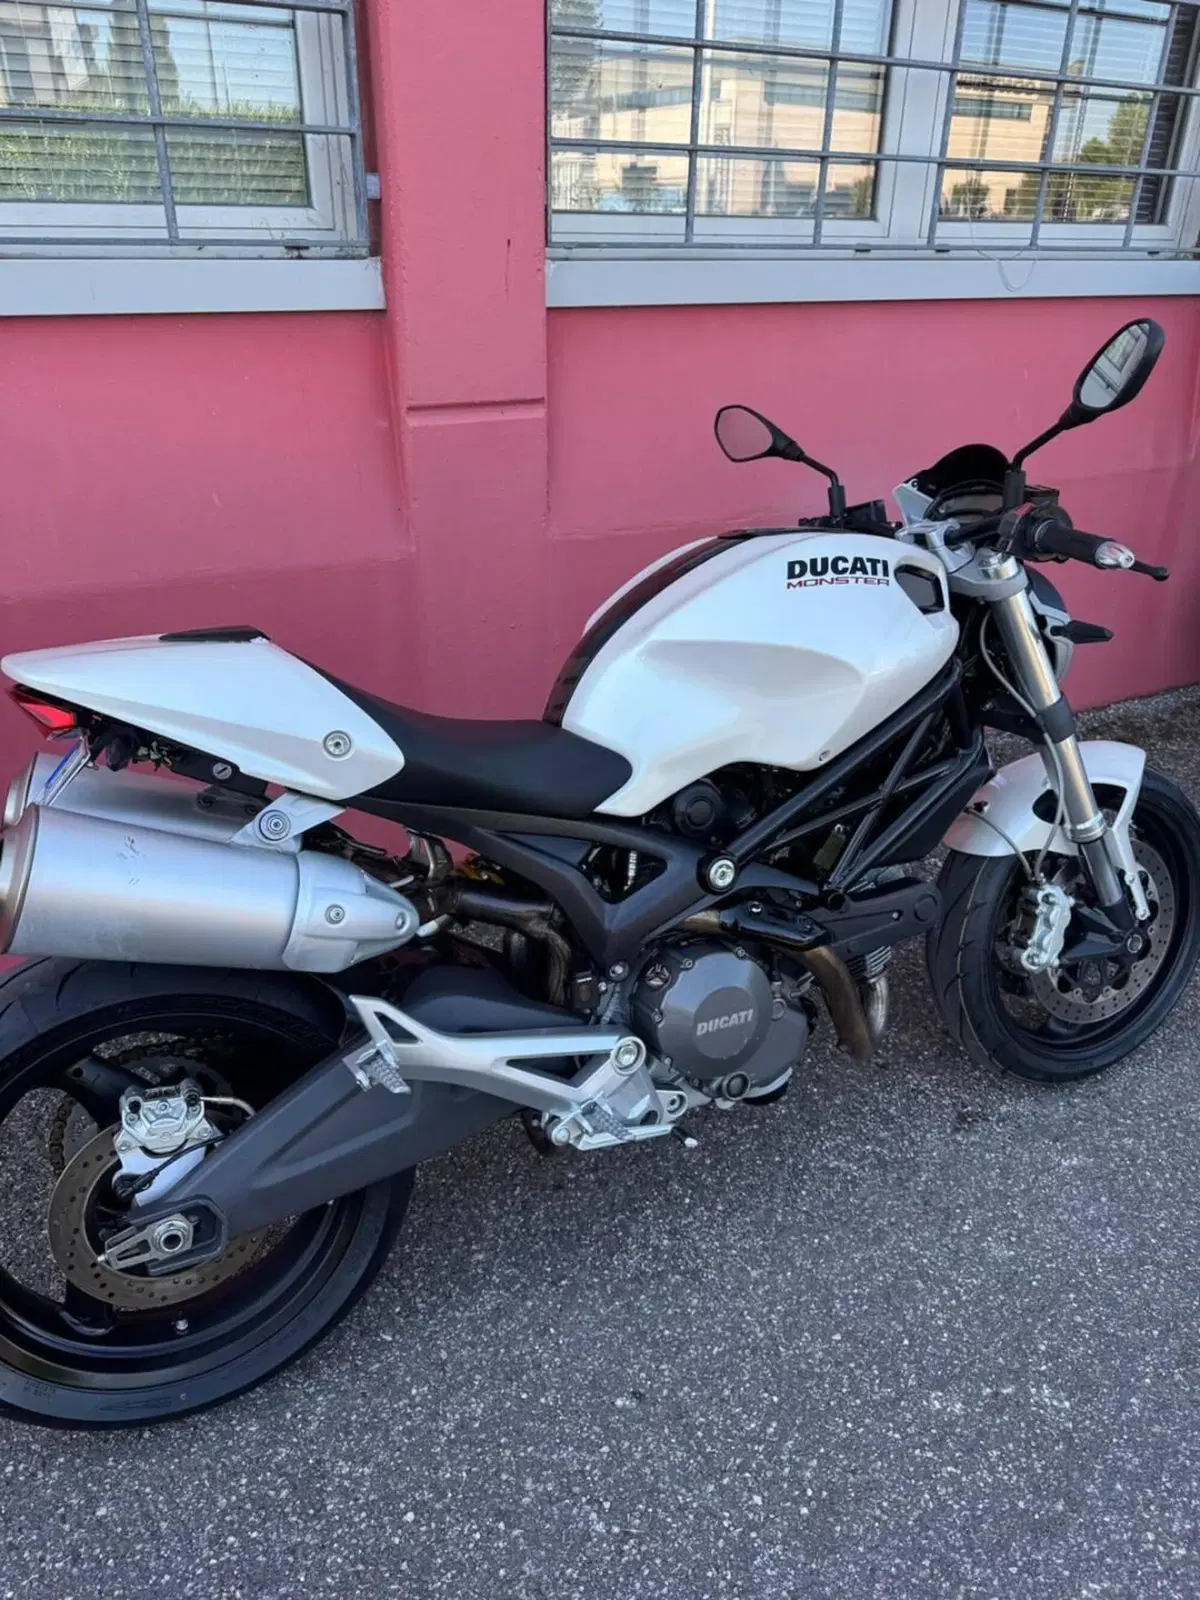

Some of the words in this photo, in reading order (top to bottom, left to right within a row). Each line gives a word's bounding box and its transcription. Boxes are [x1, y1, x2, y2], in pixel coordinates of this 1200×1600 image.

[787, 556, 889, 579] DUCATI
[786, 576, 889, 589] MONSTER
[696, 1008, 754, 1036] DUCATI
